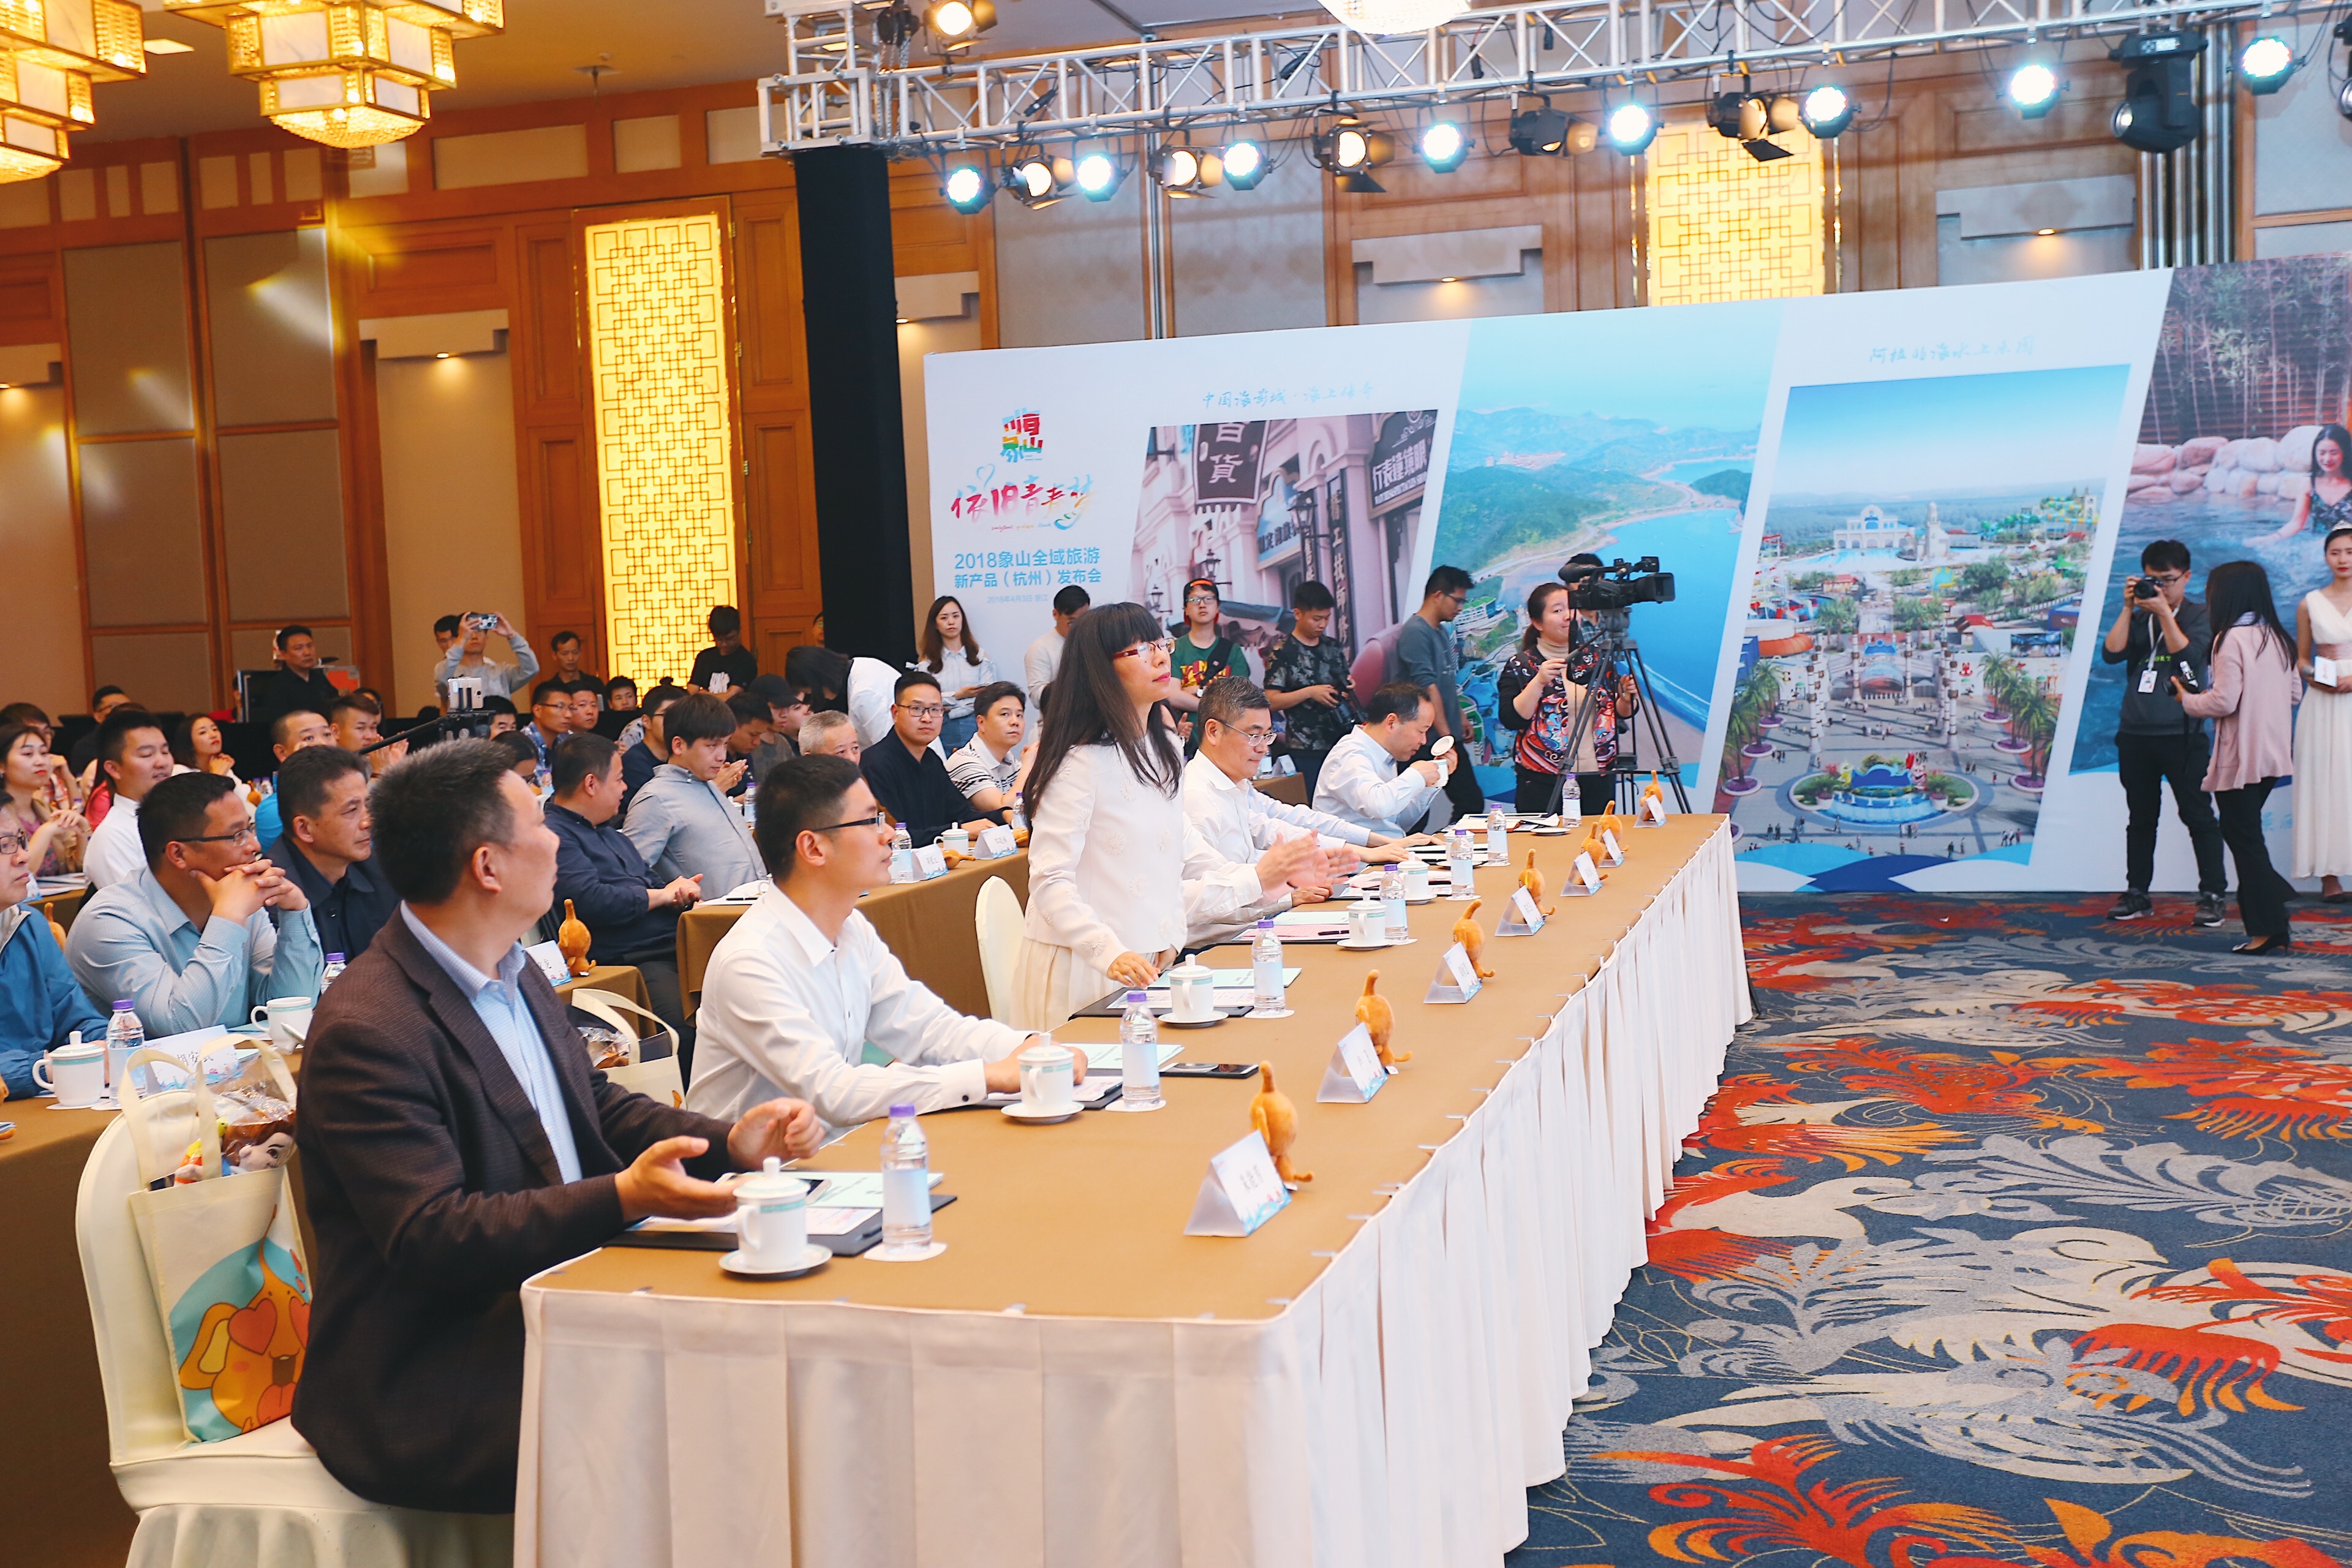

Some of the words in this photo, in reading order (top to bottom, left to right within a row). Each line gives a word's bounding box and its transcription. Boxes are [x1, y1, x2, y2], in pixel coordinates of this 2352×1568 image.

[954, 546, 1100, 570] 2018象山全域旅游
